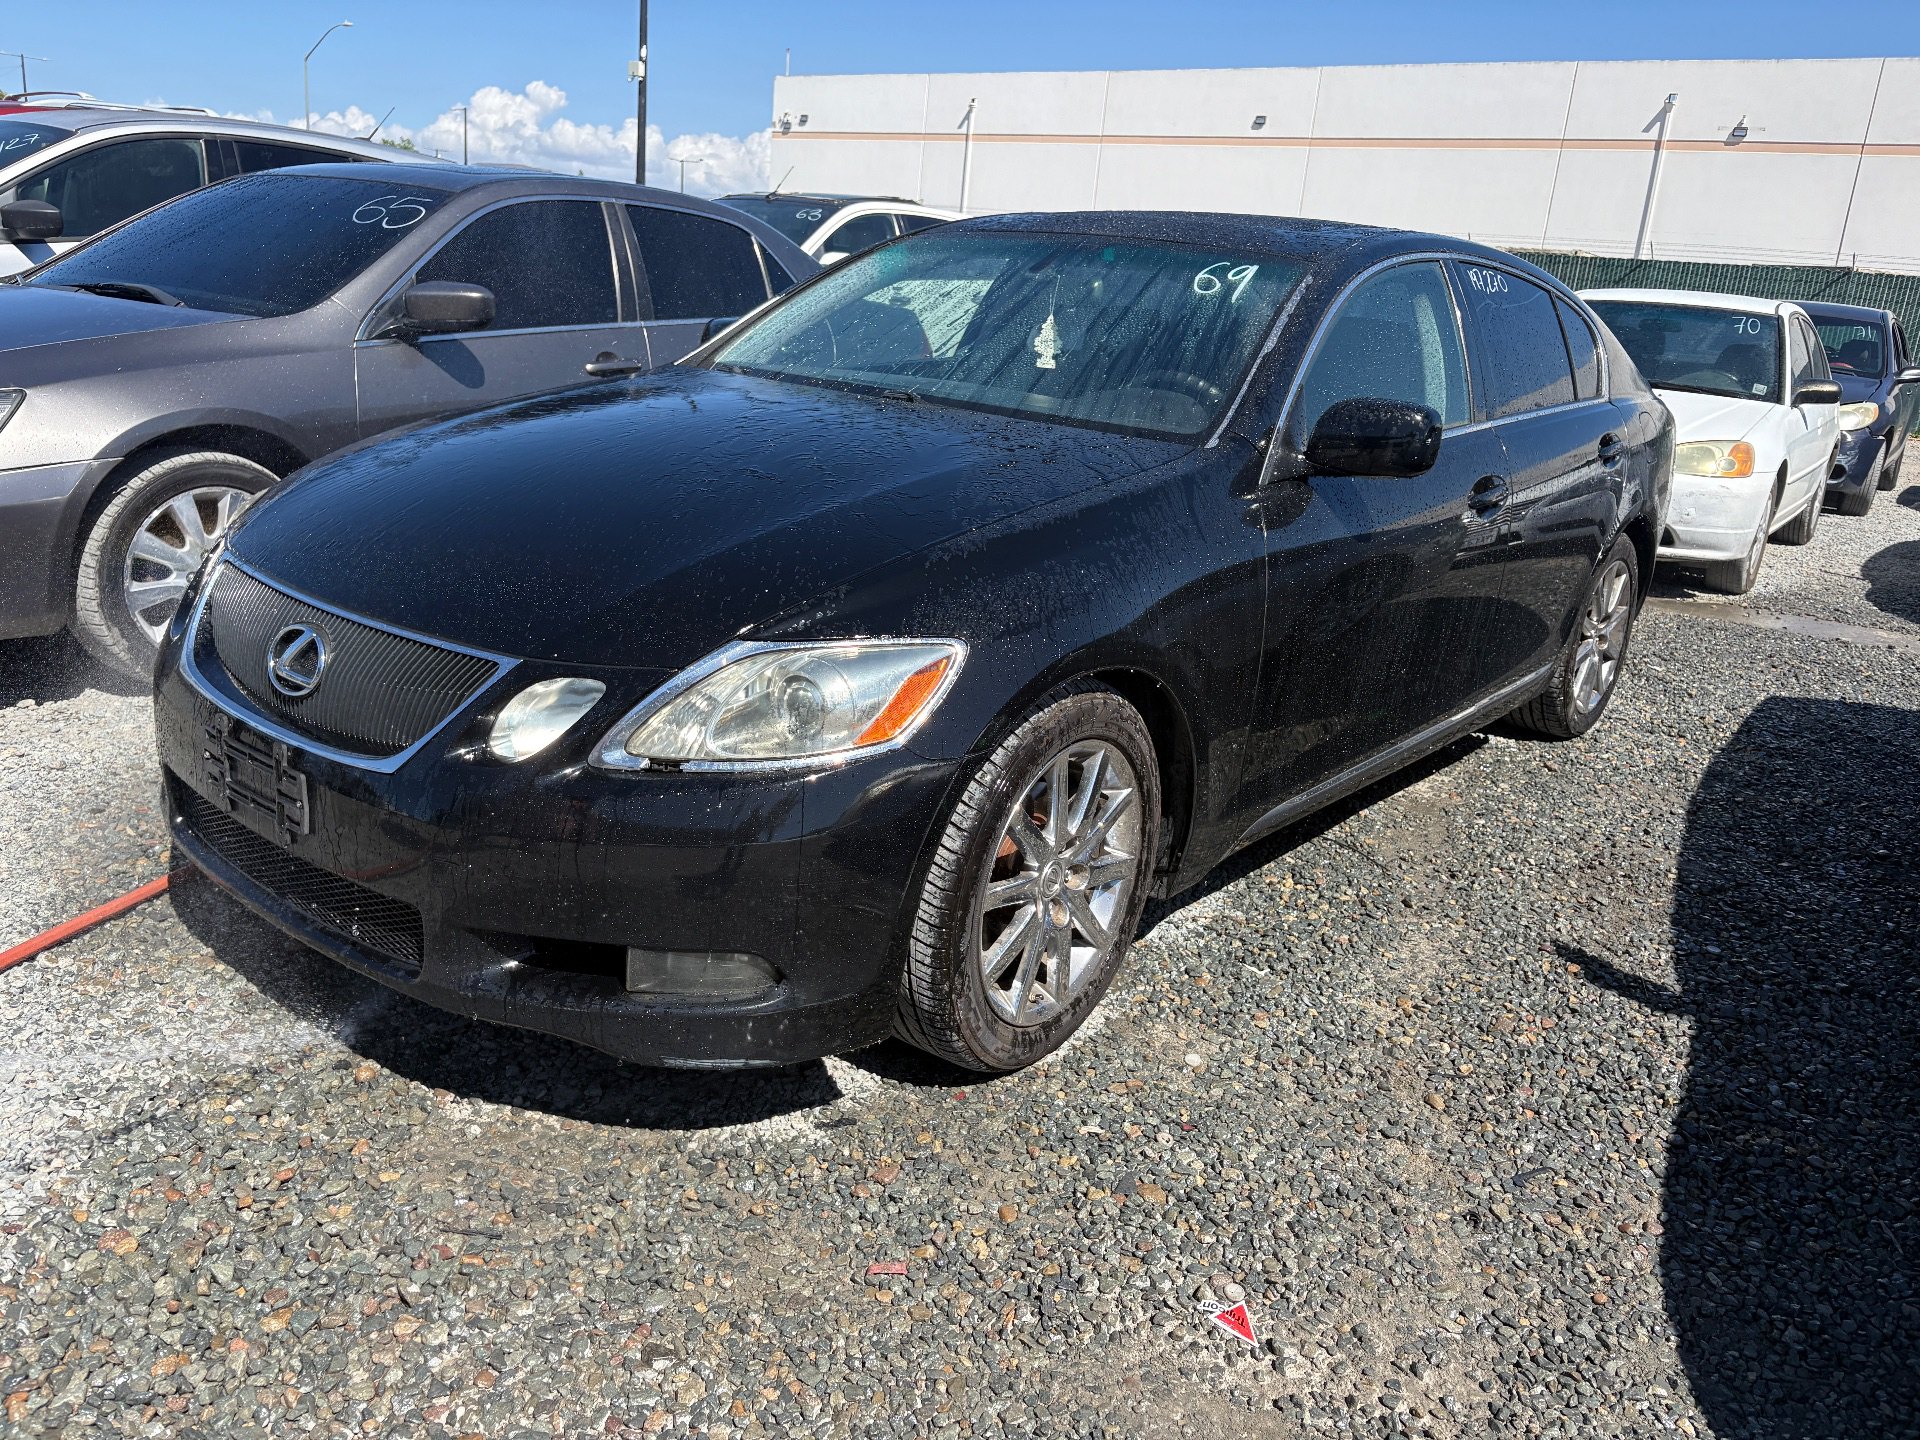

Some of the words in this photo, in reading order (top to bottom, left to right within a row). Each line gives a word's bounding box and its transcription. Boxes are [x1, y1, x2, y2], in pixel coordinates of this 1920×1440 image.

[352, 195, 433, 229] 65
[795, 208, 823, 222] 63
[1193, 261, 1260, 304] 69
[1731, 316, 1761, 335] 70
